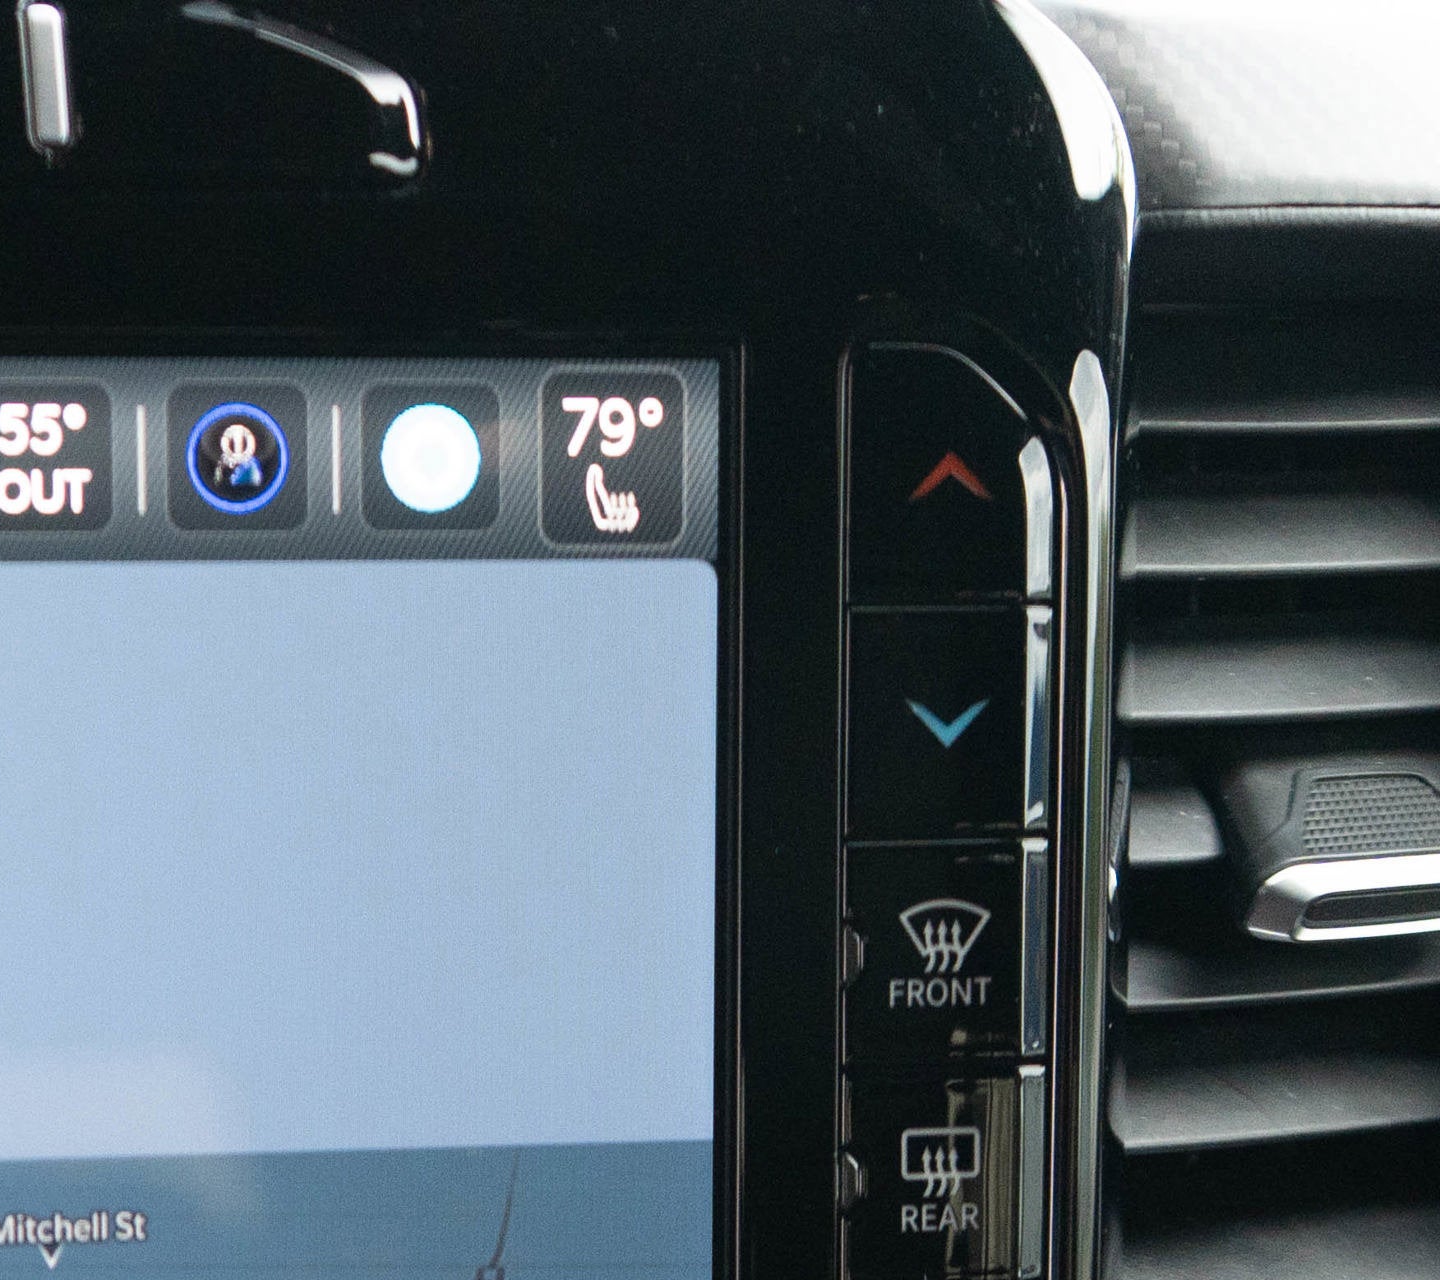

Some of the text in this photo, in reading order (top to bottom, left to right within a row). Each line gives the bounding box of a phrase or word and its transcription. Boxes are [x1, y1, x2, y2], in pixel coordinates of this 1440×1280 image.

[889, 977, 991, 1008] FRONT
[115, 1210, 147, 1240] St
[900, 1202, 979, 1232] REAR
